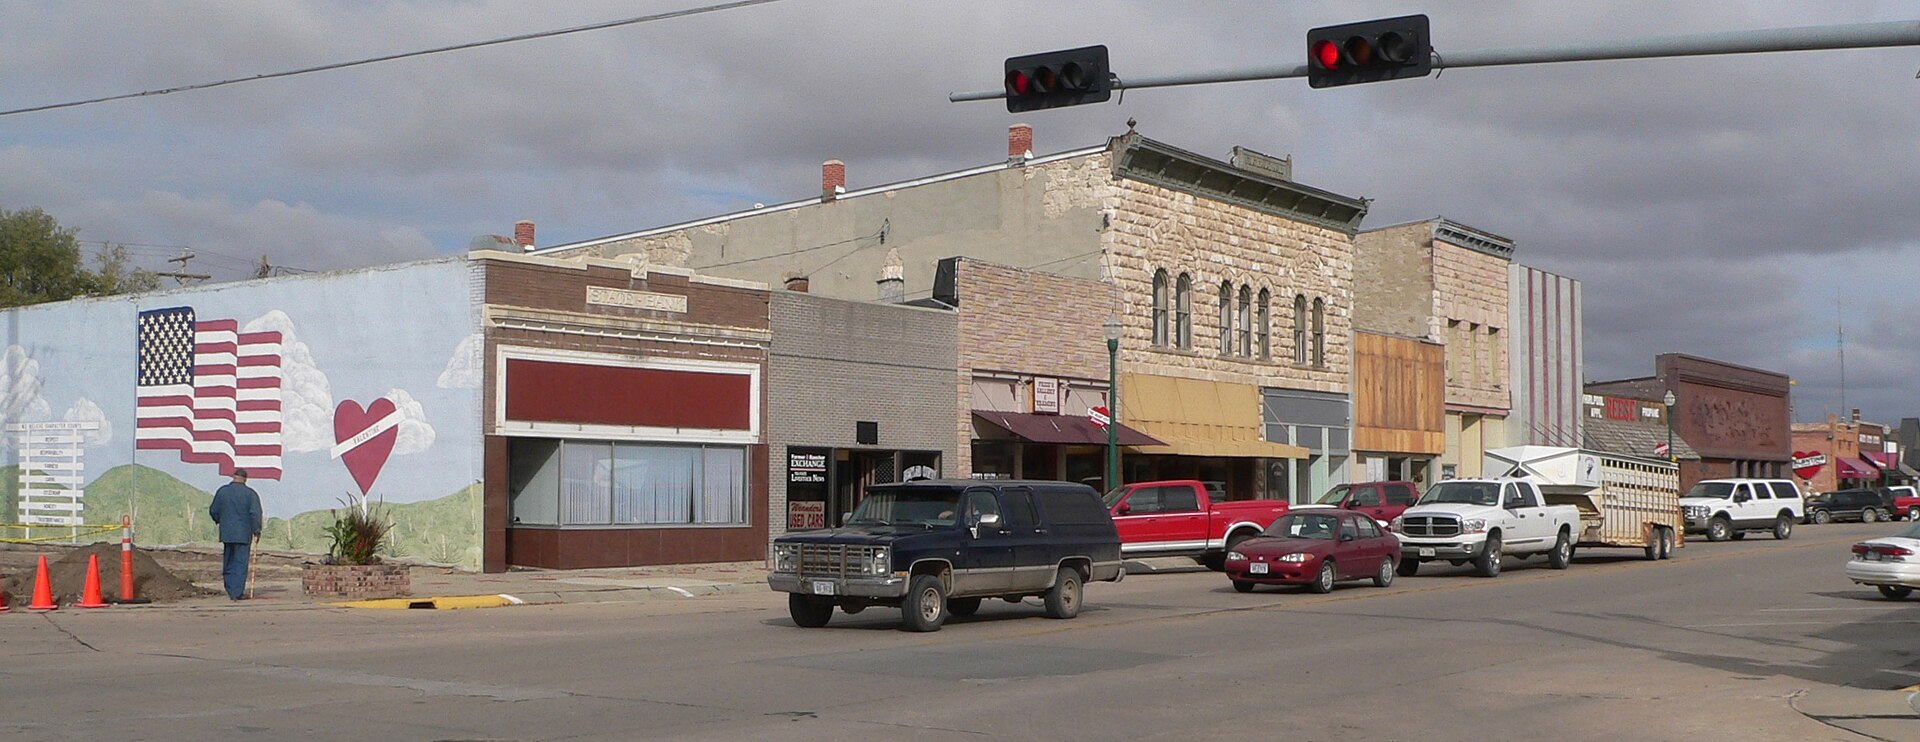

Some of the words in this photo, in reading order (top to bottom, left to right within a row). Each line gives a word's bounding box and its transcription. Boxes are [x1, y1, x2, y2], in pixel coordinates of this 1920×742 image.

[591, 289, 634, 306] STATE
[646, 294, 686, 311] BANK
[1606, 397, 1636, 421] REESE
[352, 425, 380, 445] VALENTINE
[790, 514, 804, 527] USED
[808, 514, 823, 527] CARS
